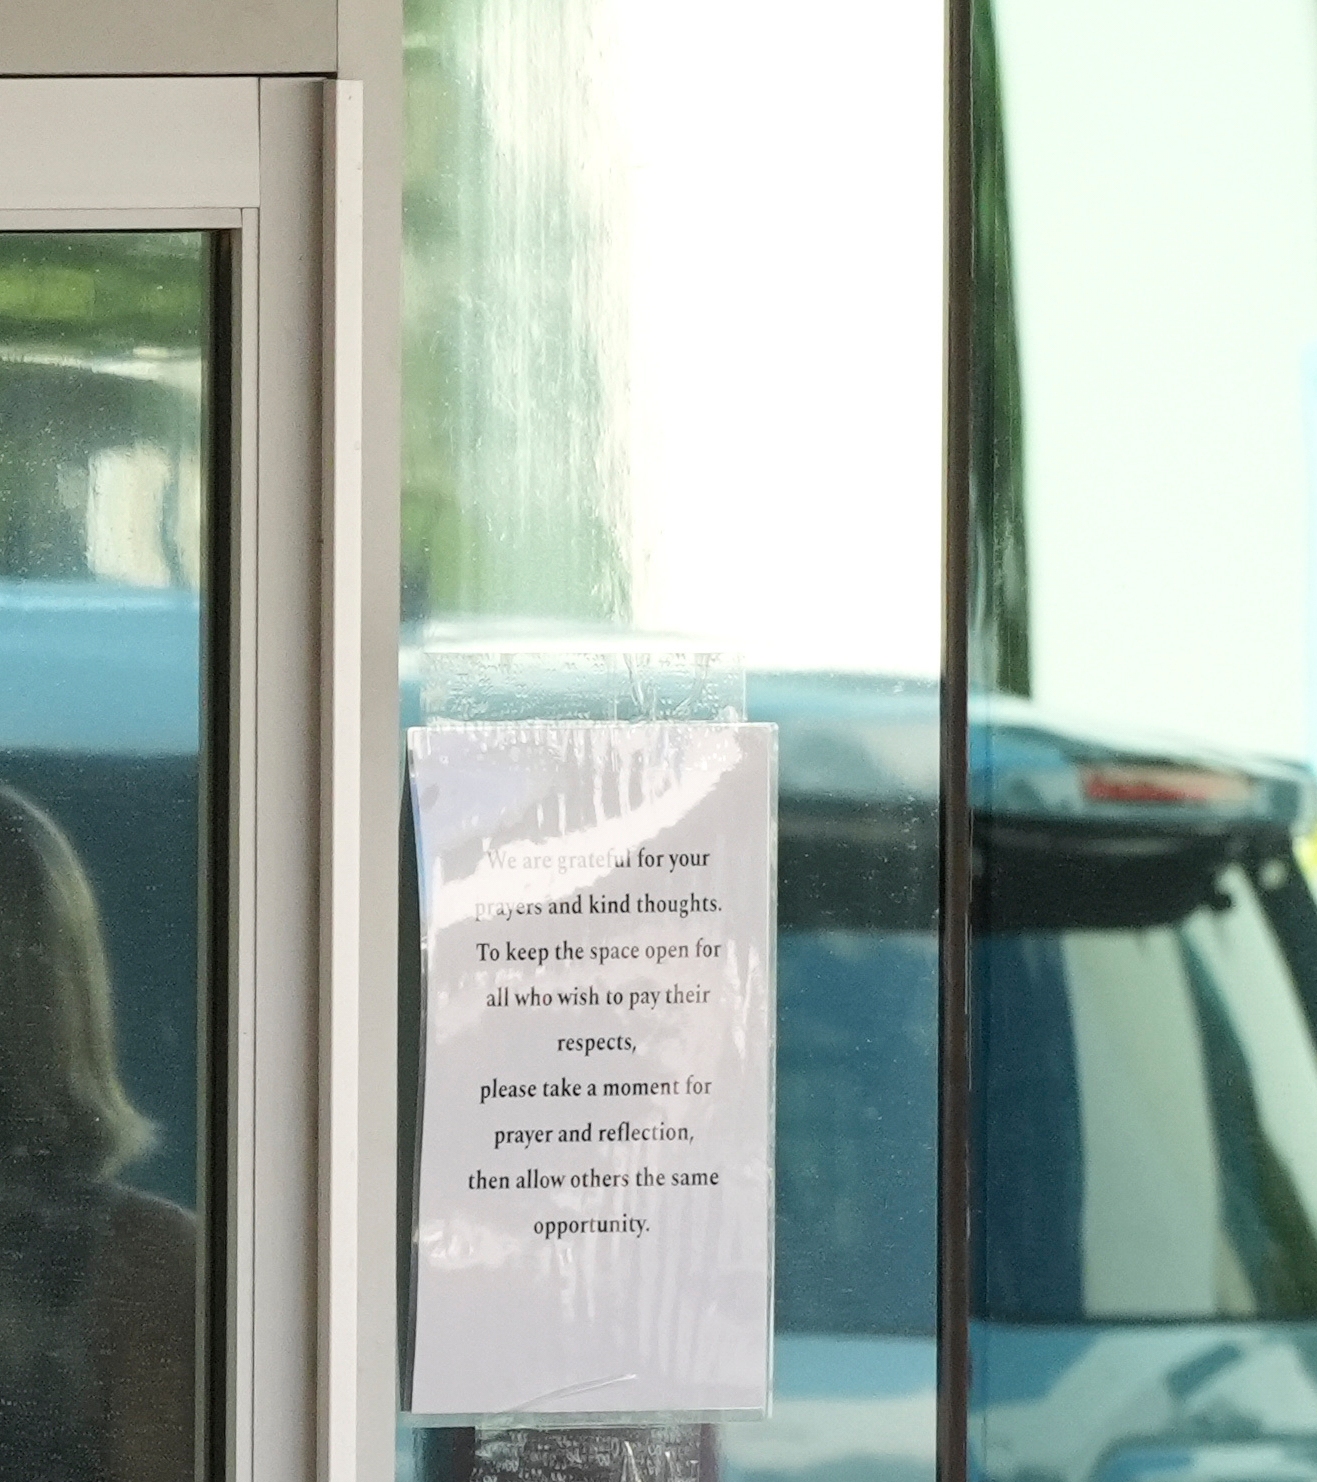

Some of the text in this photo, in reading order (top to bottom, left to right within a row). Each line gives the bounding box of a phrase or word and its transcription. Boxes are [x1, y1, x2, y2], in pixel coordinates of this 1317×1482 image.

[488, 847, 711, 874] We are grateful for your
[475, 893, 722, 921] prayers and kind thoughts.
[476, 938, 722, 966] To keep the space open for
[486, 984, 711, 1010] all who wish to pay their
[557, 1035, 637, 1056] respects,
[480, 1074, 712, 1104] please take a moment for
[494, 1121, 695, 1150] prayer and reflection,
[468, 1167, 719, 1190] then allow others the same
[533, 1213, 650, 1240] opportunity.
